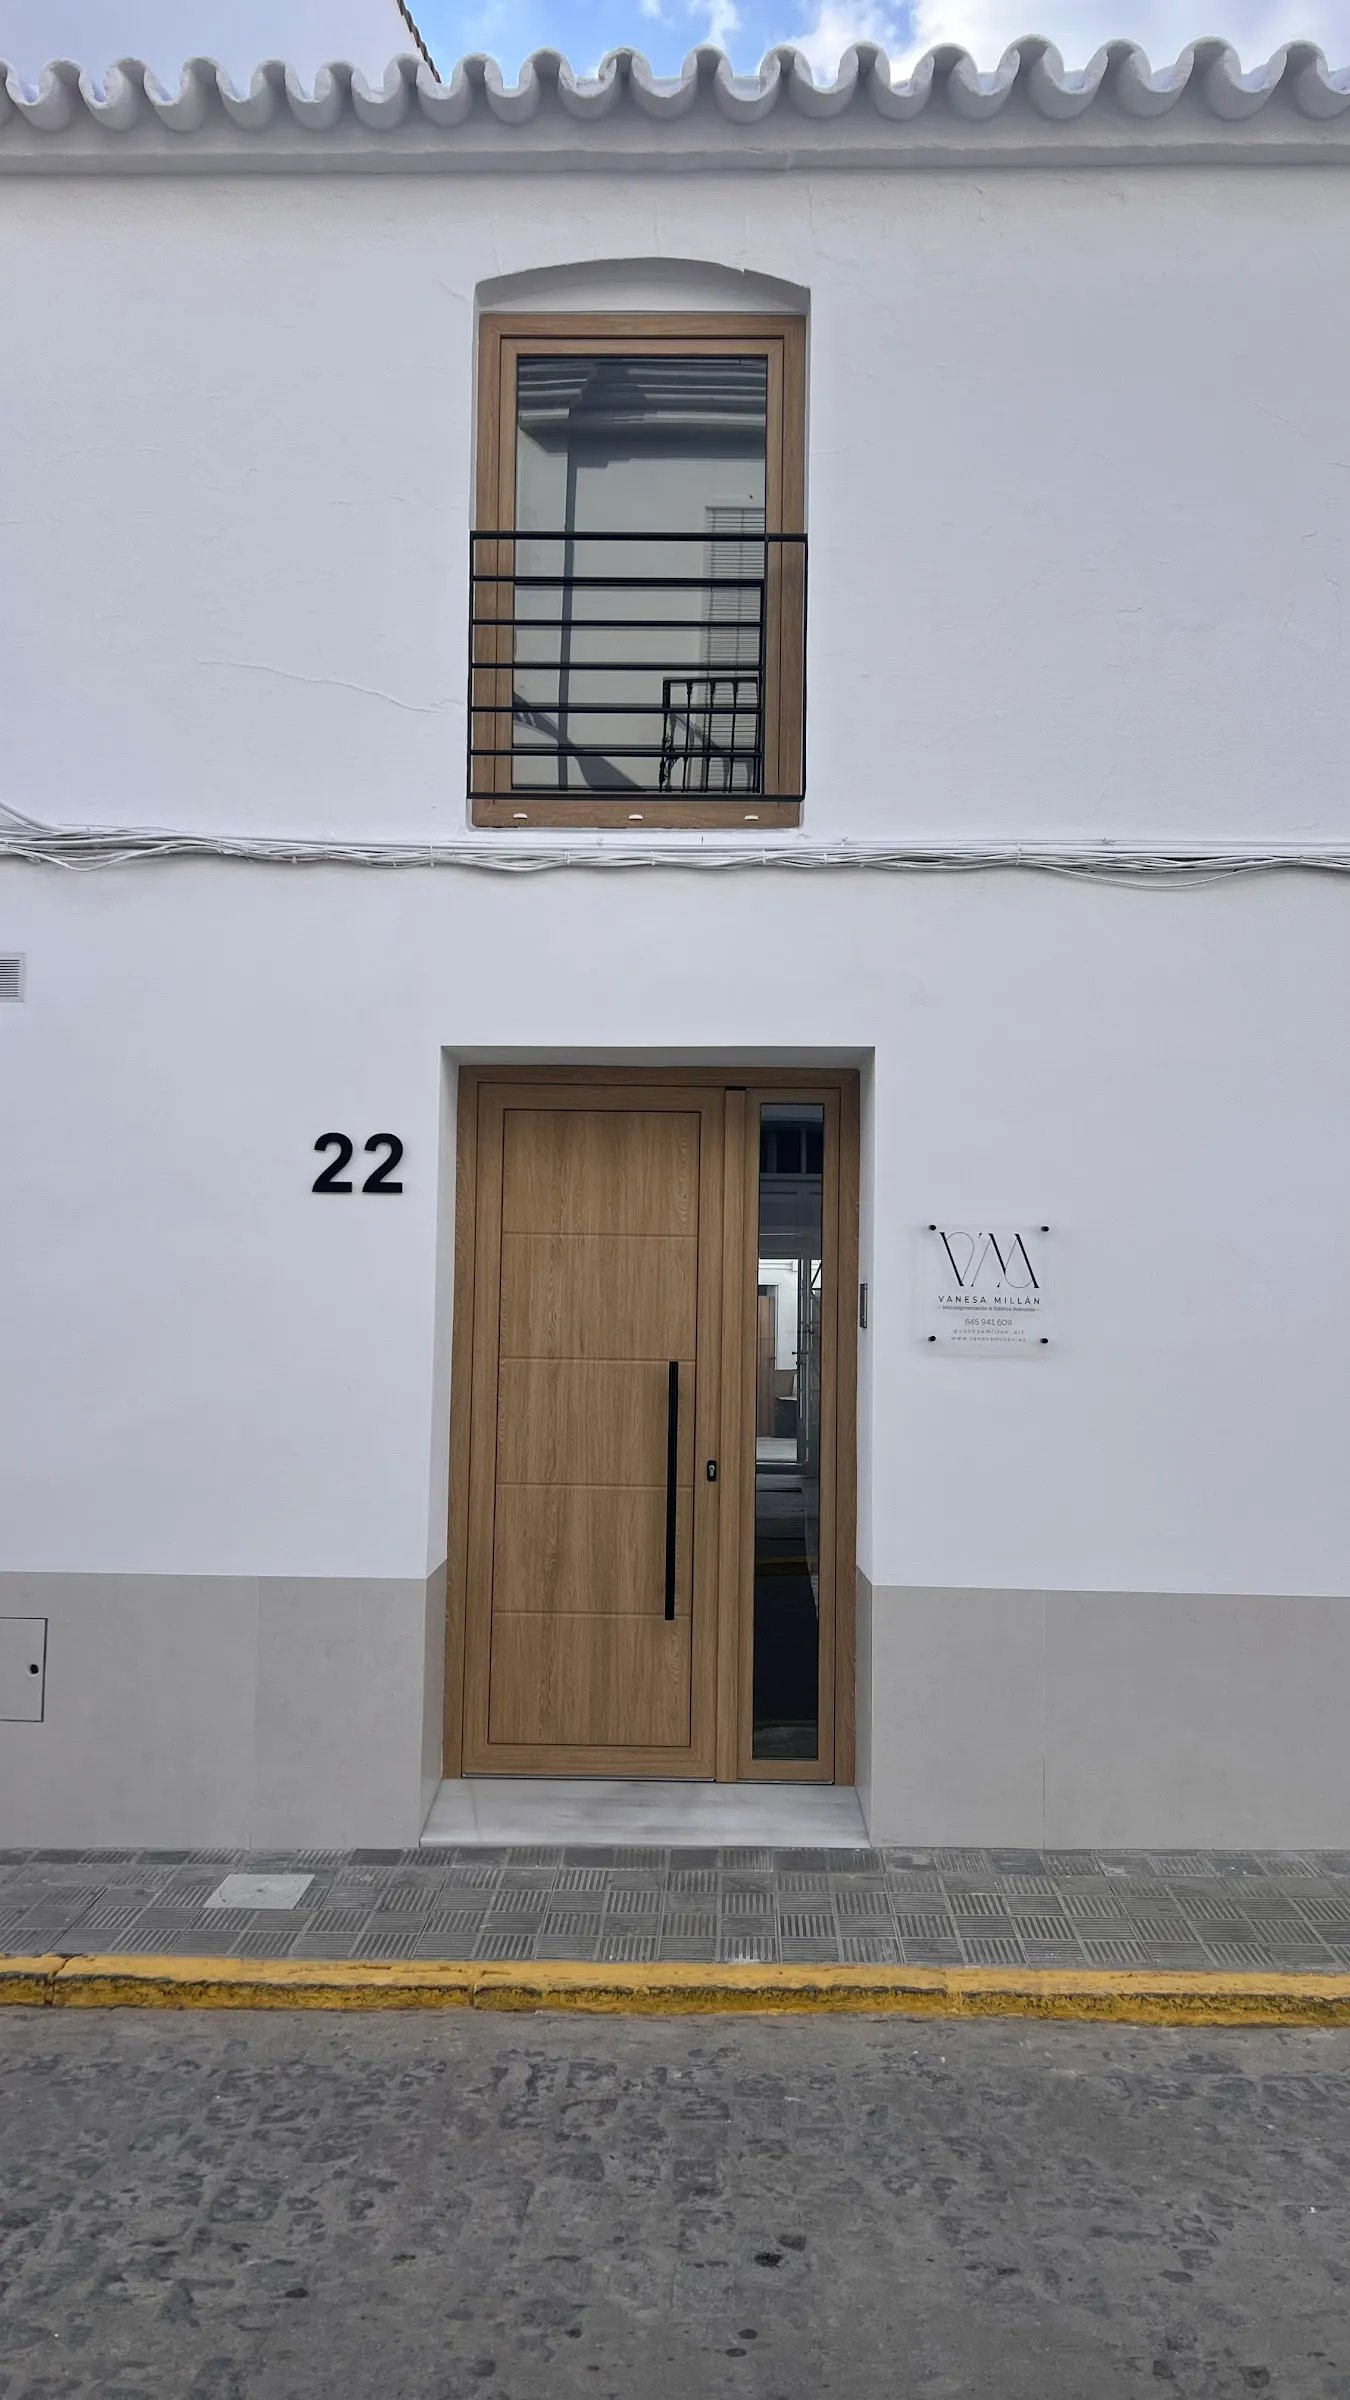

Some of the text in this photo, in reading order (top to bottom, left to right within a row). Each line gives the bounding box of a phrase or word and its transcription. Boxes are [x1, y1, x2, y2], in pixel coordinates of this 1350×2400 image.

[312, 1132, 403, 1193] 22
[938, 1296, 1040, 1305] VANESA MILLÁN
